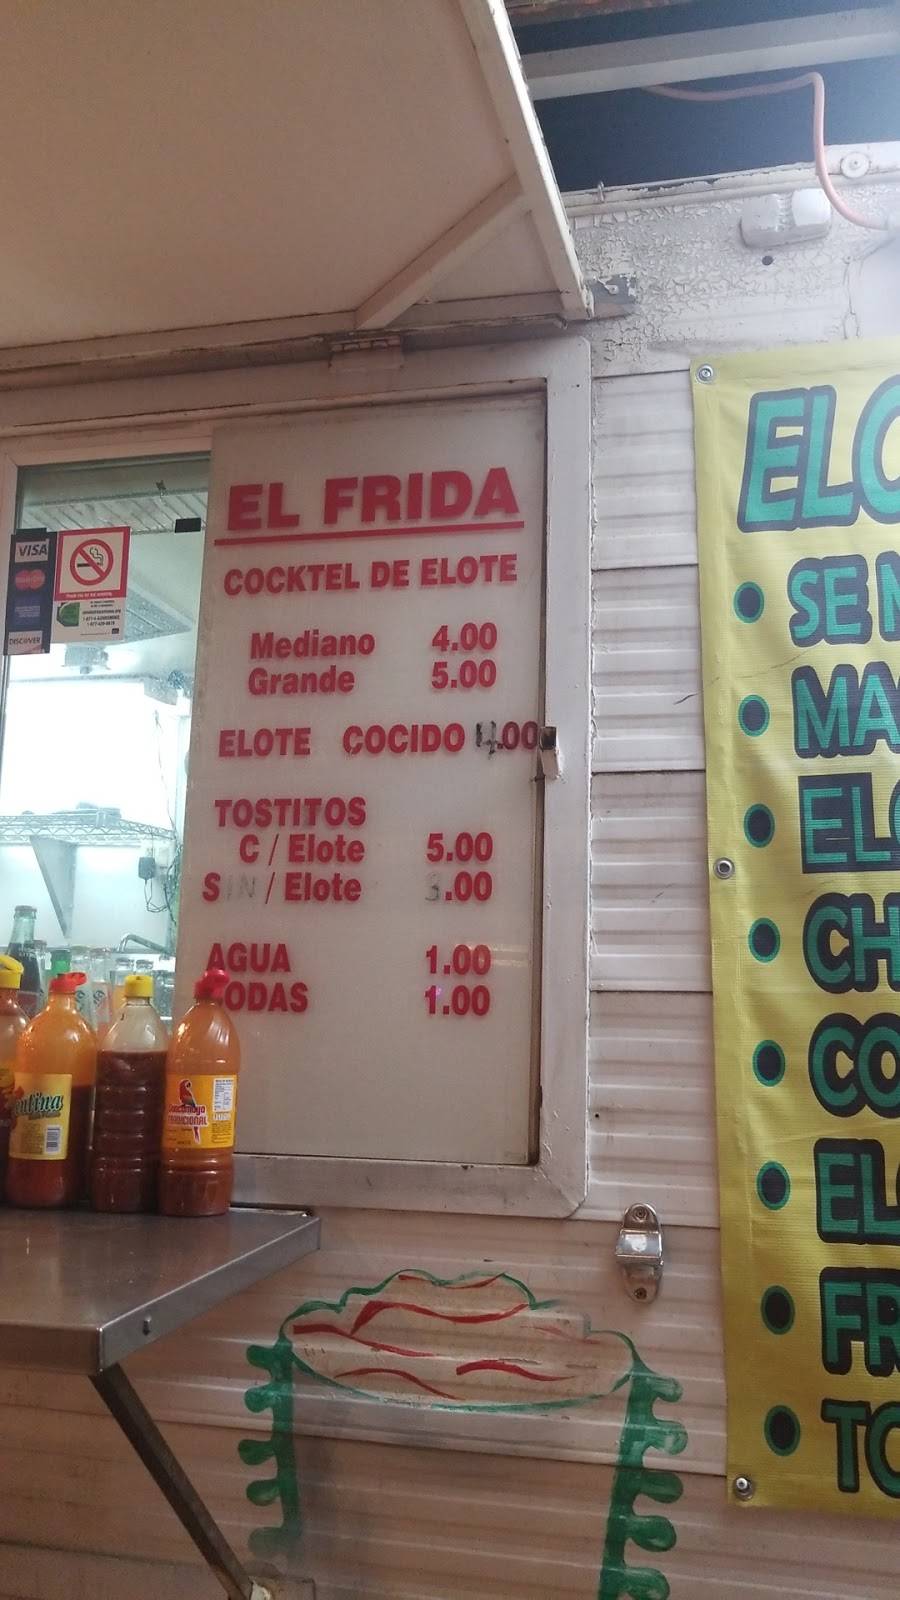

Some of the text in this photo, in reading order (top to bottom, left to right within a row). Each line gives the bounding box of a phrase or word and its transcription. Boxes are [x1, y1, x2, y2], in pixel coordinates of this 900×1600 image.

[228, 468, 518, 532] EL FRIDA
[18, 543, 48, 557] VISA
[224, 553, 518, 597] COCKTEL DE ELOTE
[250, 622, 498, 661] Mediano 4.00
[247, 659, 497, 696] Grande 5.00
[791, 661, 900, 758] MA
[218, 727, 312, 758] ELOTE
[341, 722, 466, 756] COCIDO
[214, 796, 368, 829] TOSTITOS
[798, 772, 900, 873] EL
[426, 831, 495, 864] 5.00
[205, 942, 493, 976] AGUA 1.00
[220, 979, 492, 1017] ODAS 1.00
[815, 1137, 900, 1244] EL
